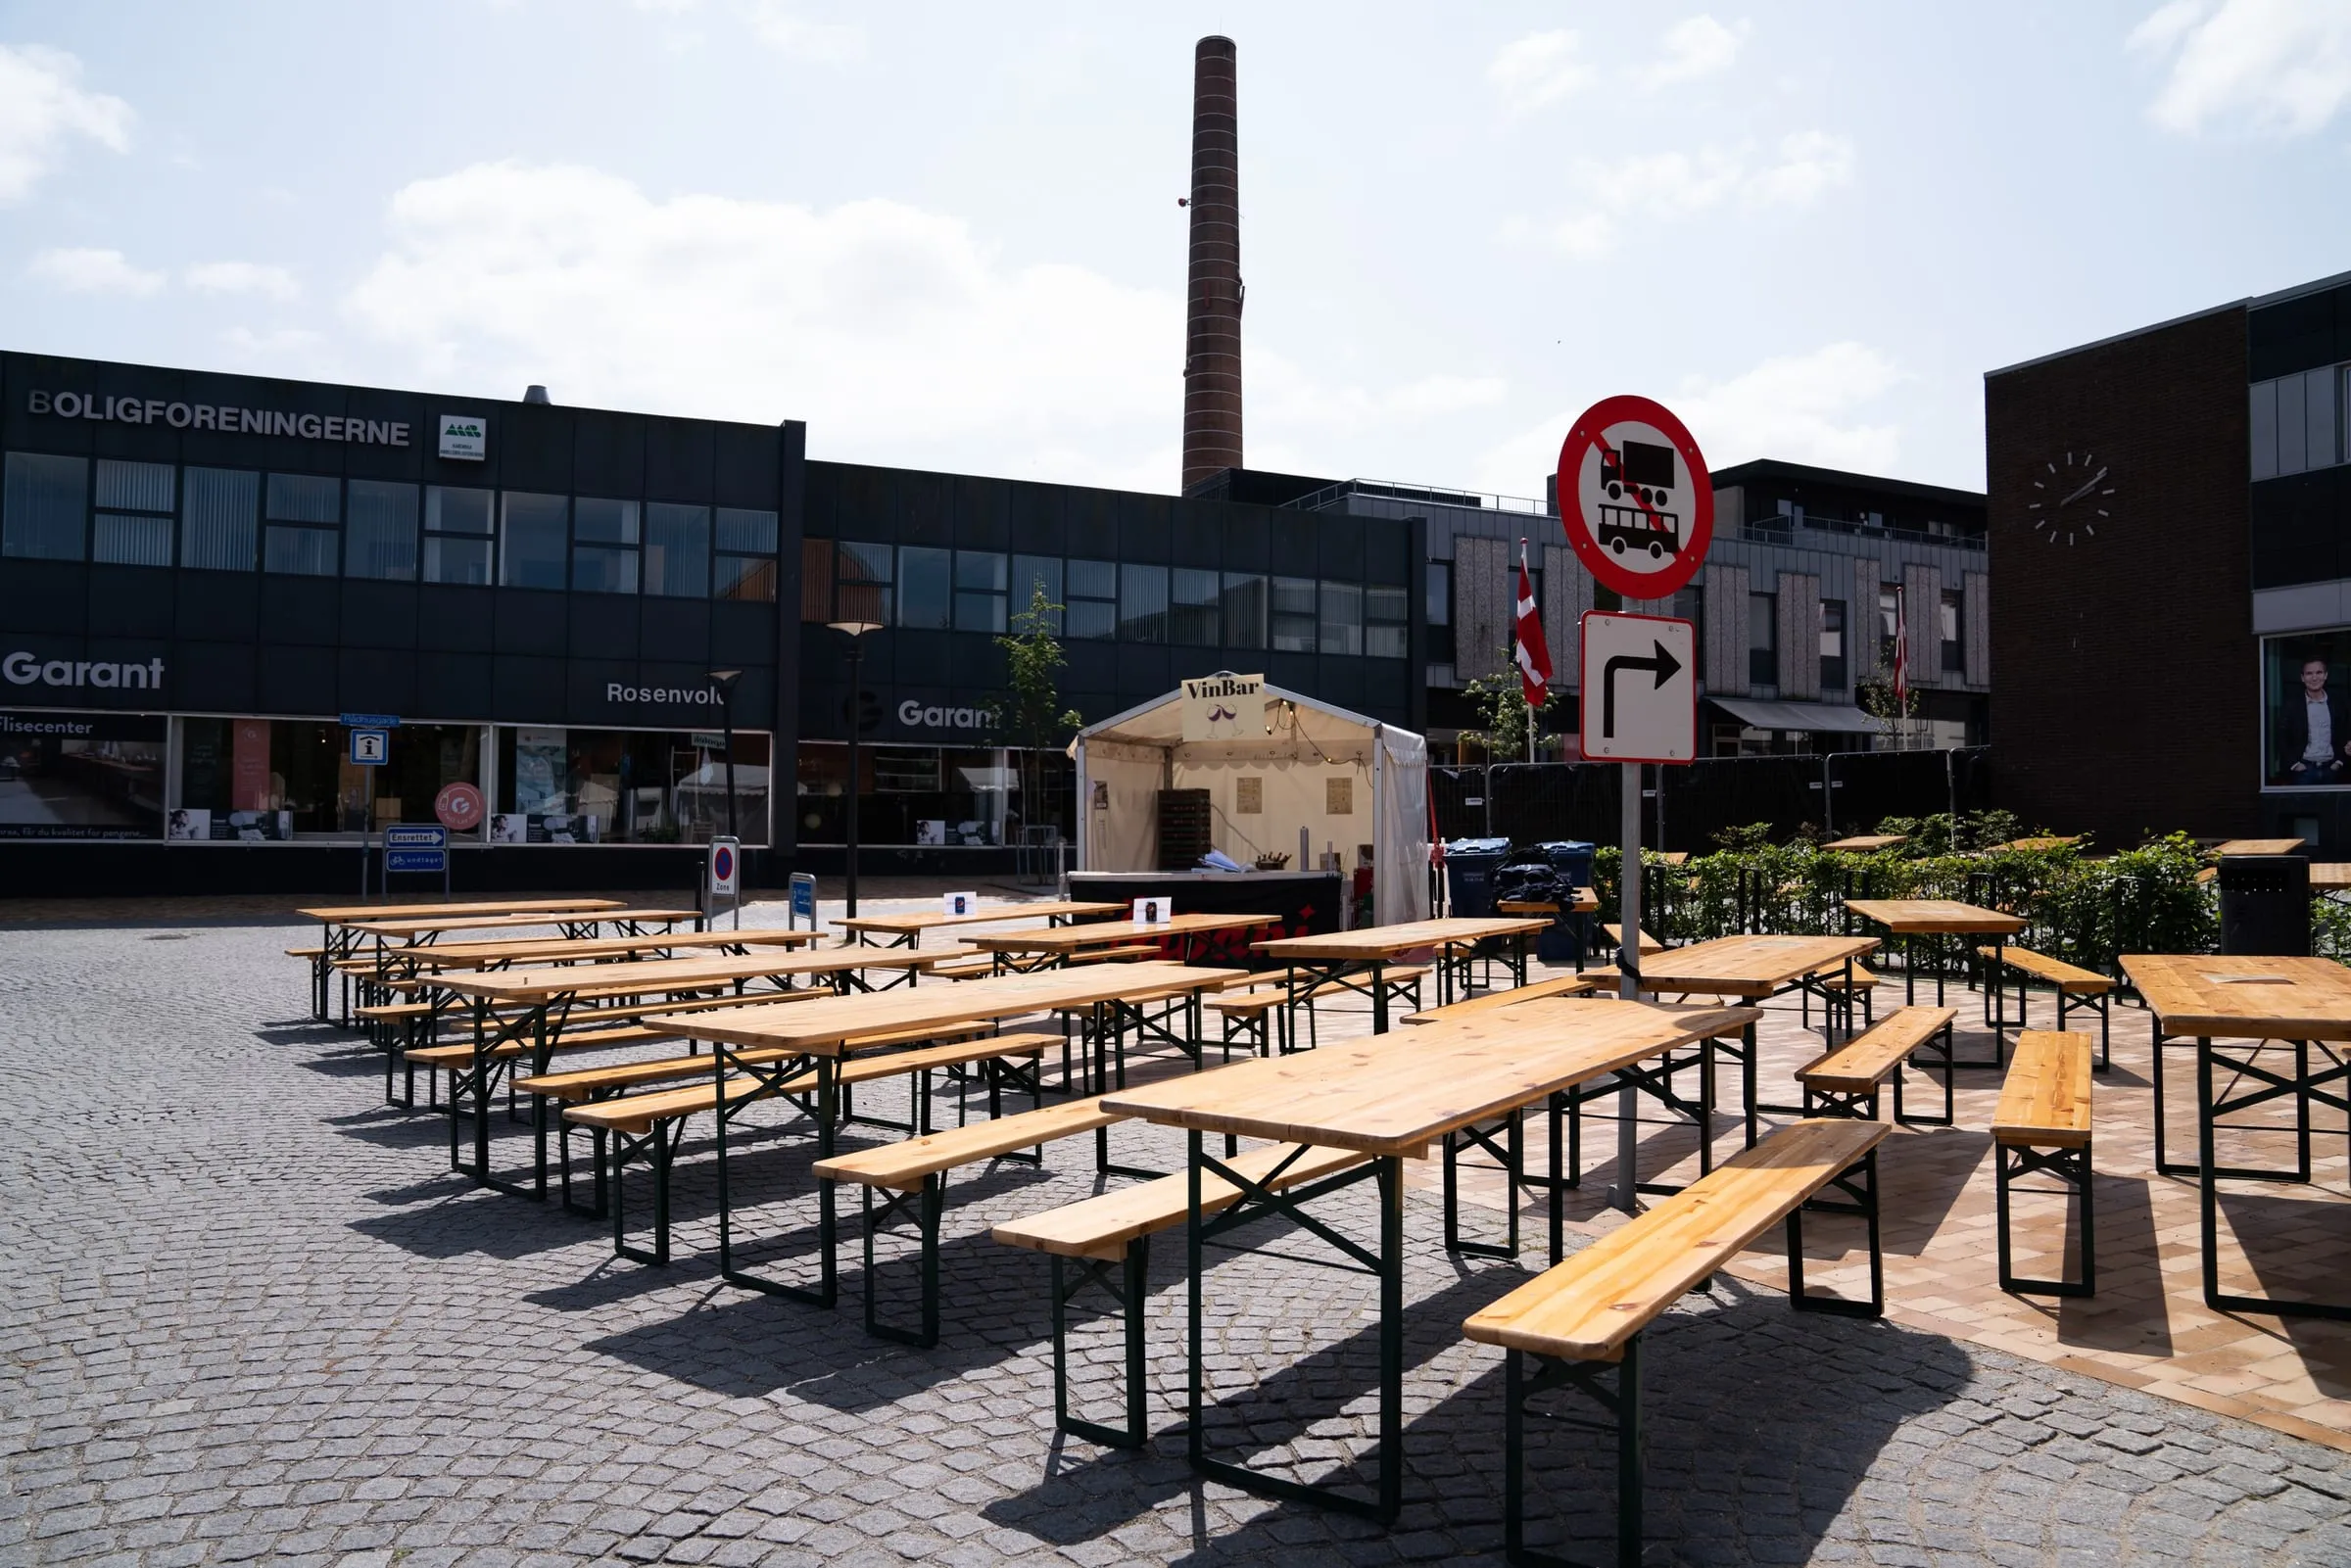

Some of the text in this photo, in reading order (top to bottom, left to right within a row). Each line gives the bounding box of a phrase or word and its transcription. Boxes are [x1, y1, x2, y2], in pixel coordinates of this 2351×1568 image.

[27, 390, 410, 447] BOLIGFORENINGERNE
[2, 651, 165, 689] Garant
[1187, 680, 1259, 699] VinBar
[37, 827, 50, 836] du
[392, 833, 433, 842] Ensrettet
[407, 856, 443, 865] undtaget
[716, 882, 730, 892] Zone
